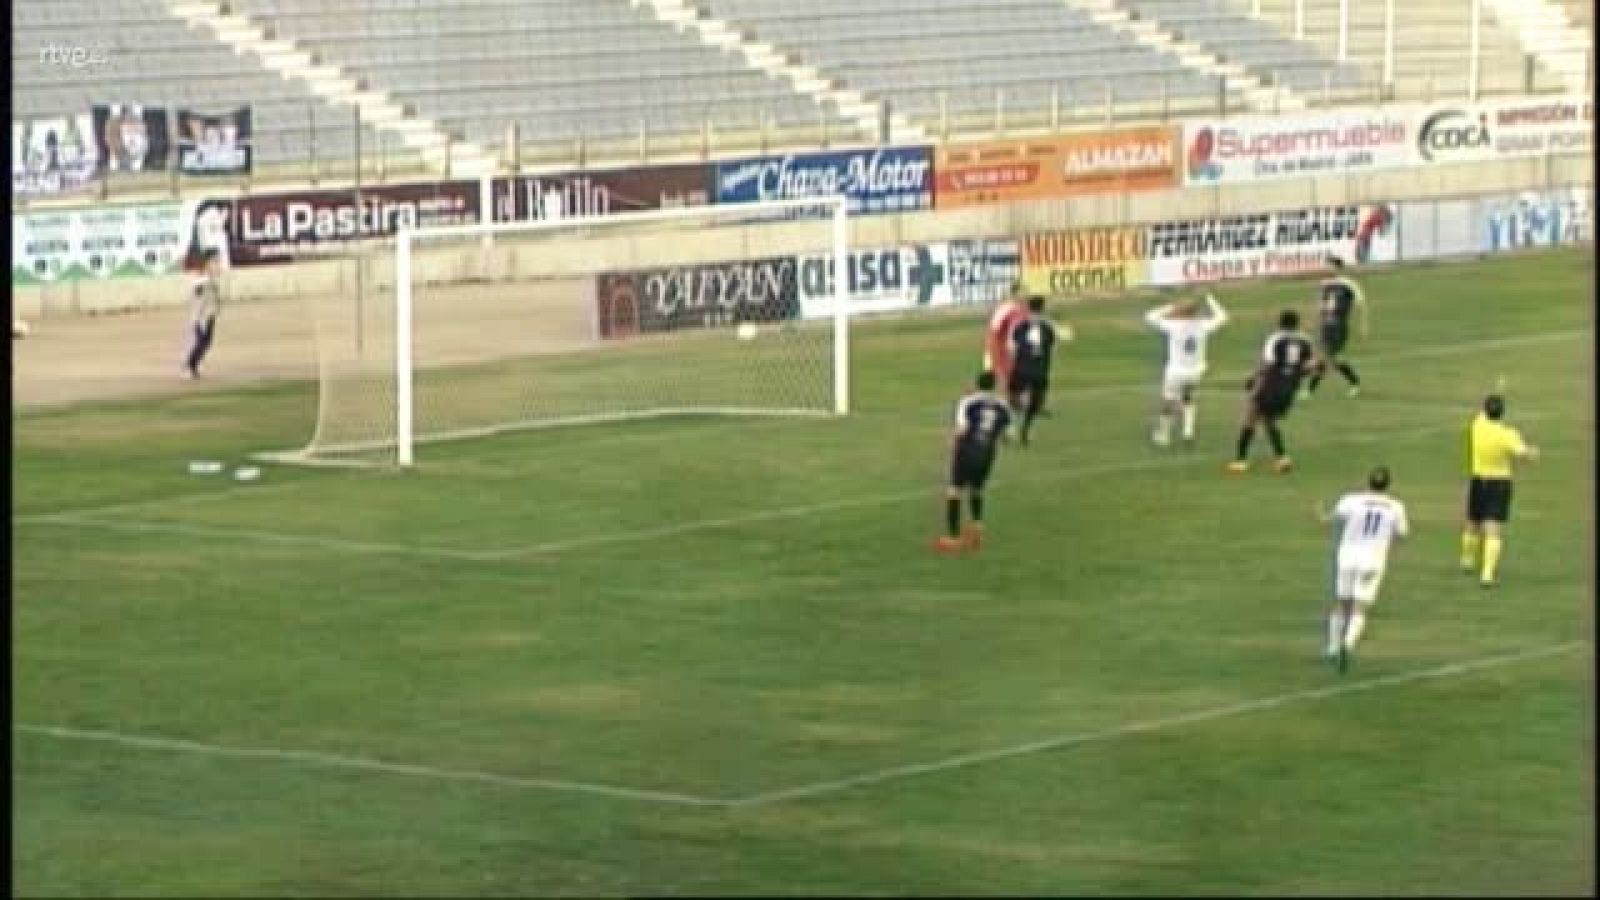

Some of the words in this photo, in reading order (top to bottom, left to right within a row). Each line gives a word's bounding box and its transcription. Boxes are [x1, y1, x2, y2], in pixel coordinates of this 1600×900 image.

[1218, 118, 1406, 158] Supermueble
[242, 206, 282, 240] La
[287, 194, 417, 239] Pastira
[1276, 205, 1359, 247] HIDALGO
[1182, 257, 1243, 283] Chapa
[1363, 508, 1384, 538] 11
